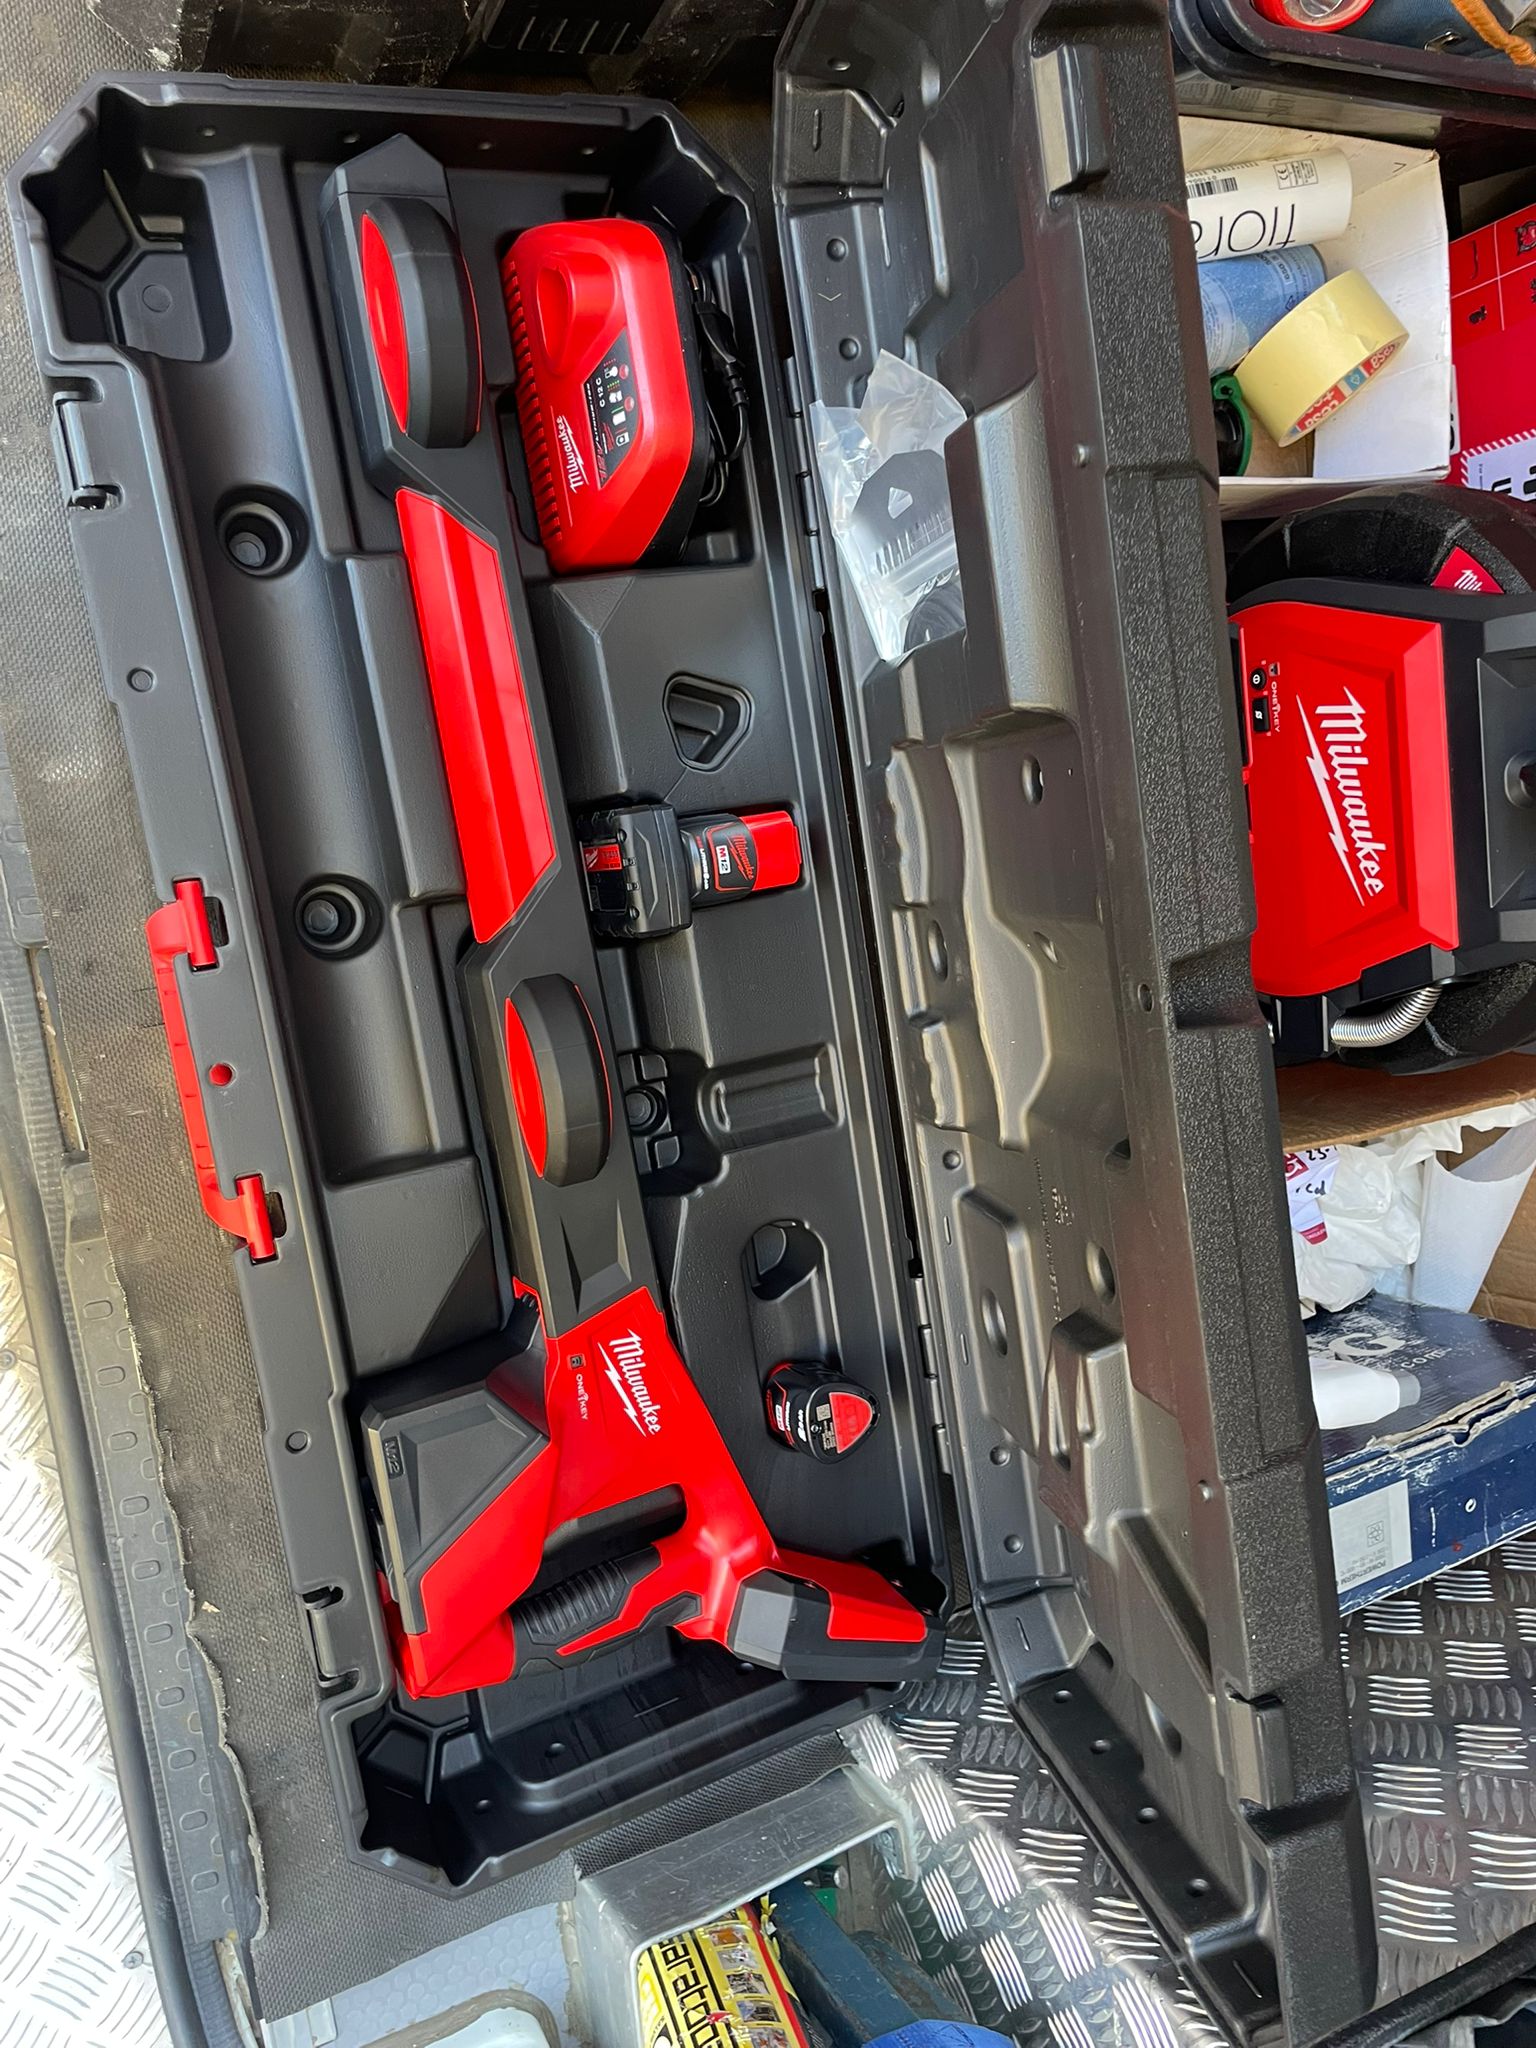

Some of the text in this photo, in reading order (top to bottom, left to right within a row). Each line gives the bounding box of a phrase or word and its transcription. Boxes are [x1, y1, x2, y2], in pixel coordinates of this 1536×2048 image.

[557, 415, 585, 494] Milwaukee
[1314, 686, 1385, 898] Milwaukee
[718, 847, 729, 872] M12
[731, 834, 755, 881] Milwaukee
[609, 1328, 661, 1436] Milwaukee
[385, 1440, 400, 1473] M12
